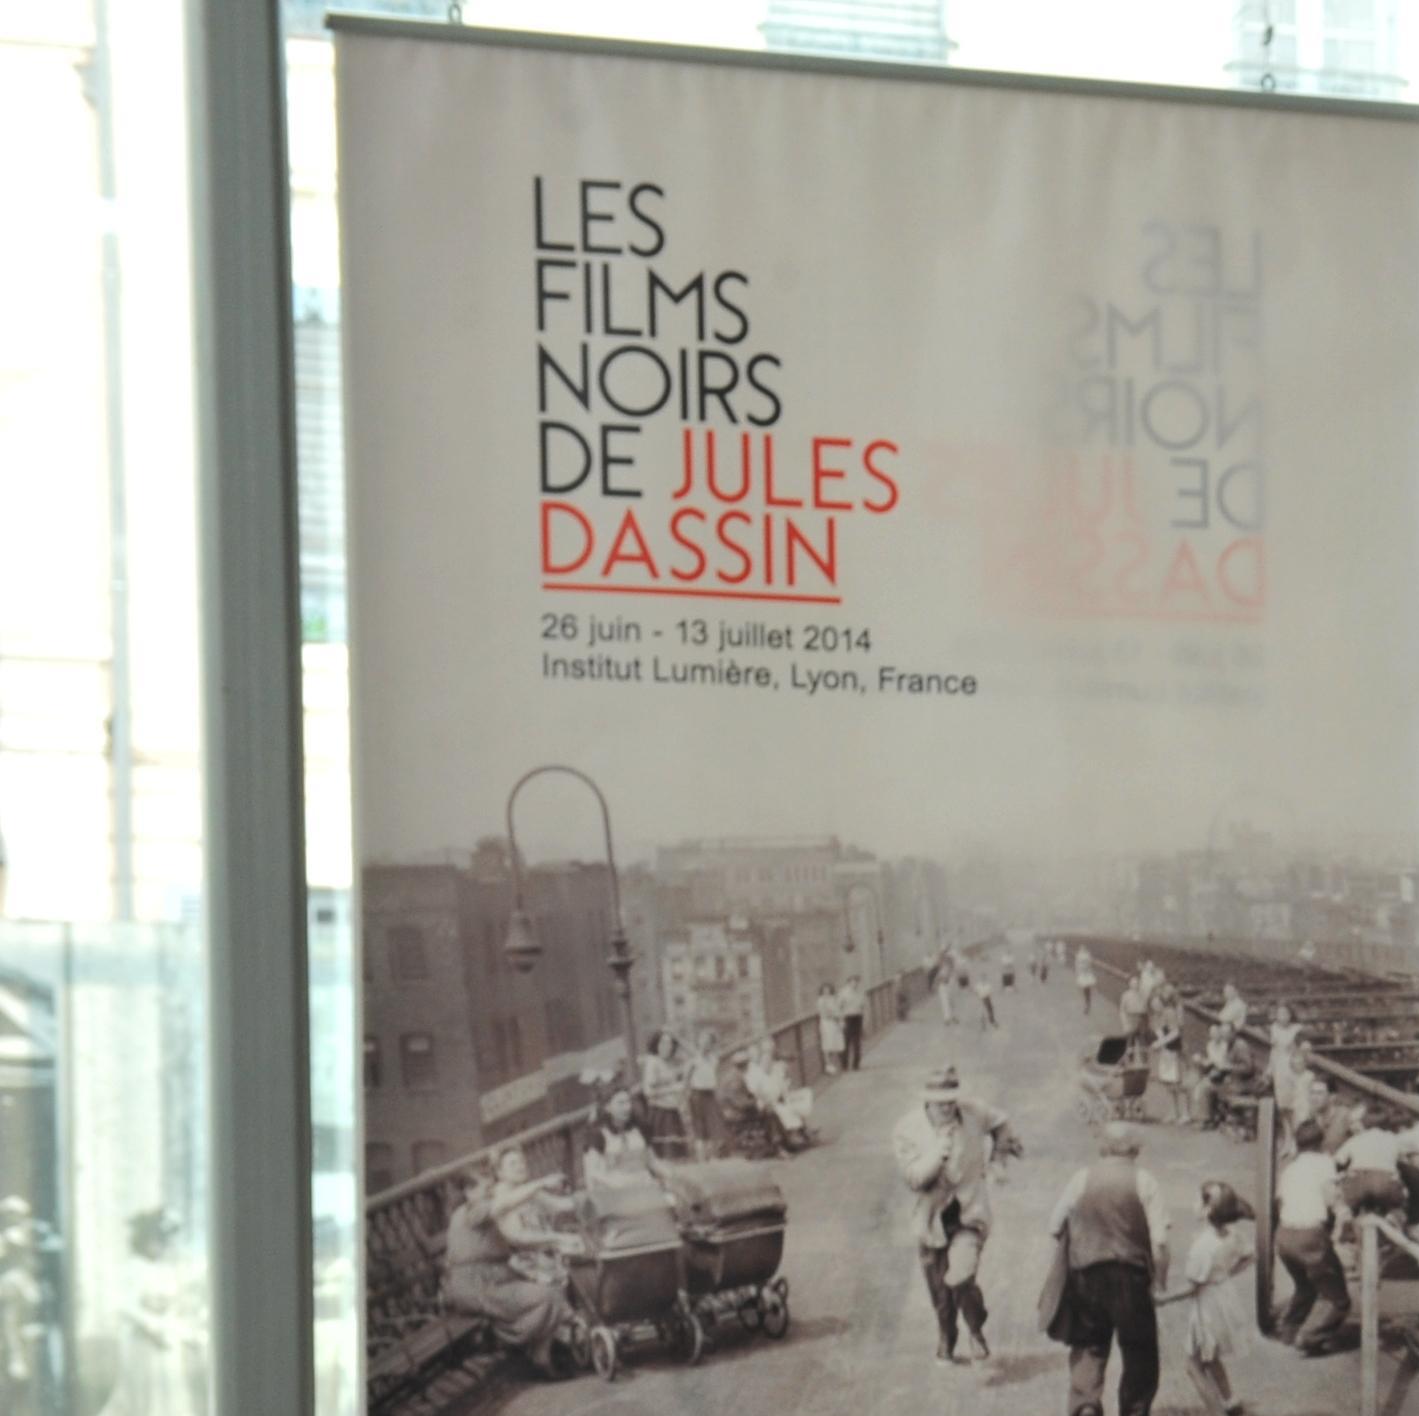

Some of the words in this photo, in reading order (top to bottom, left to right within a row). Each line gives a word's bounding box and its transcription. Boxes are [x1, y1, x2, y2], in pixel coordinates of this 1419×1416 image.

[532, 174, 667, 260] LES
[534, 256, 751, 347] FILMS
[536, 340, 784, 429] NOIRS
[537, 418, 644, 500] DE
[671, 427, 901, 516] JULES
[539, 499, 838, 588] DASSIN
[541, 612, 579, 641] 26
[588, 616, 641, 647] juin
[677, 619, 709, 646] 13
[717, 621, 794, 653] juillet
[803, 624, 873, 653] 2014
[541, 653, 642, 682] Institut
[653, 656, 780, 692] Lumière,
[790, 663, 868, 696] Lyon,
[878, 665, 979, 696] France
